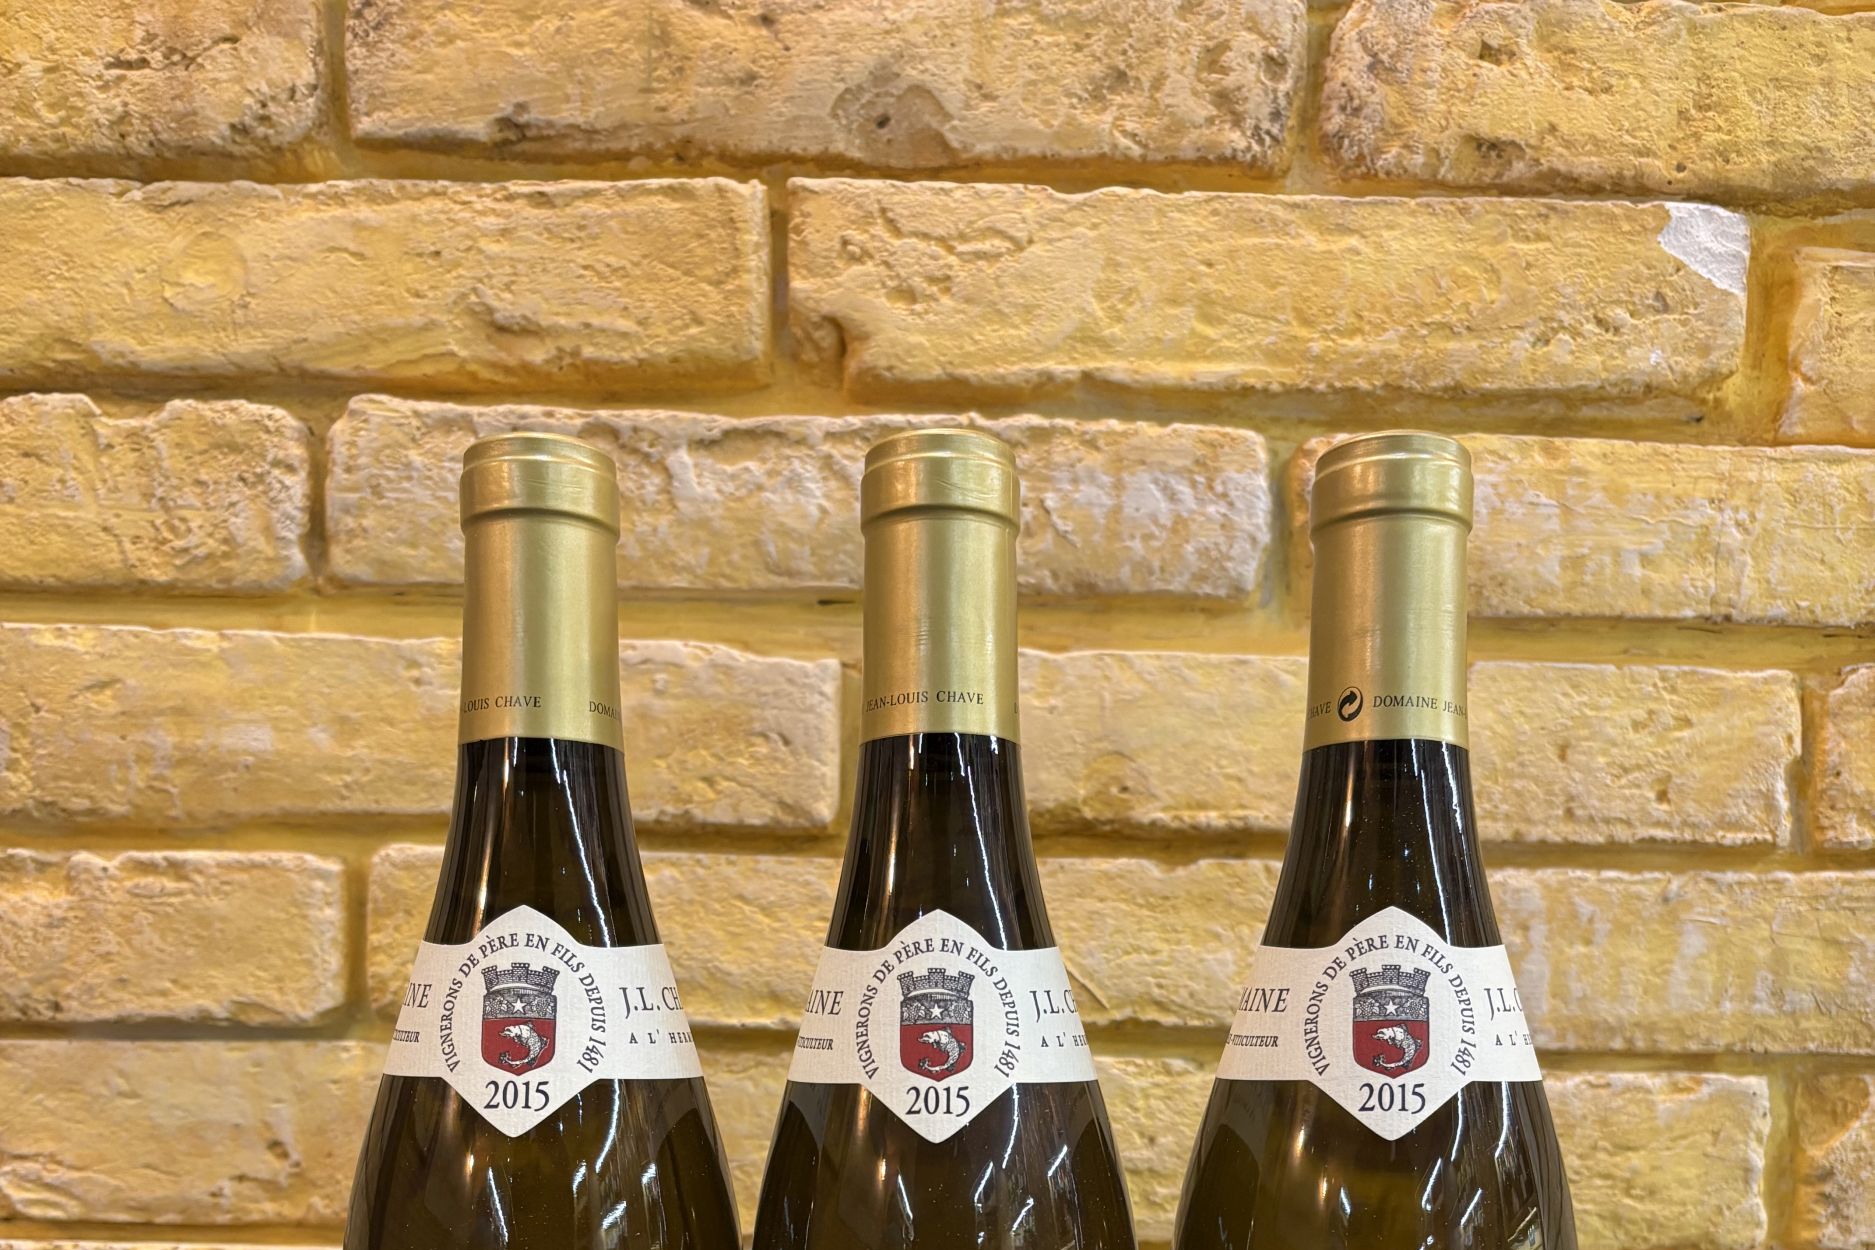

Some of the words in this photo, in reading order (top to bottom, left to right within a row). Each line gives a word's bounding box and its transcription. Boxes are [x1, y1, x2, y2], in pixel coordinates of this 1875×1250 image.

[495, 696, 541, 708] CHAVE
[866, 691, 928, 712] JEAN-LOUIS
[936, 690, 983, 705] CHAVE
[1373, 695, 1438, 710] DOMAINE
[478, 932, 519, 959] PÈRE
[524, 933, 550, 952] EN
[893, 938, 935, 964] PÈRE
[940, 938, 964, 956] EN
[1345, 935, 1389, 961] PÈRE
[1394, 935, 1420, 953] EN
[459, 953, 480, 978] DE
[551, 943, 585, 973] FILS
[873, 960, 895, 984] DE
[966, 947, 998, 978] FILS
[1322, 957, 1347, 980] DE
[1421, 944, 1453, 974] FILS
[578, 973, 606, 1033] DEPUIS
[618, 986, 660, 1019] J.L.
[993, 977, 1020, 1037] DEPUIS
[1029, 990, 1065, 1023] J.L.
[1449, 974, 1476, 1035] DEPUIS
[1484, 987, 1516, 1021] J.L.
[440, 978, 463, 1073] VIGNERONS
[629, 1032, 639, 1044] A
[648, 1029, 660, 1044] L'
[856, 984, 880, 1080] VIGNERONS
[1040, 1035, 1049, 1048] A
[1056, 1031, 1066, 1048] L'
[1304, 981, 1330, 1076] VIGNERONS
[1495, 1034, 1503, 1046] A
[1509, 1030, 1518, 1046] L'
[576, 1036, 606, 1074] 1481
[994, 1041, 1021, 1077] 1481
[1451, 1038, 1477, 1076] 1481
[483, 1080, 550, 1112] 2015
[905, 1086, 970, 1117] 2015
[1358, 1083, 1426, 1115] 2015
